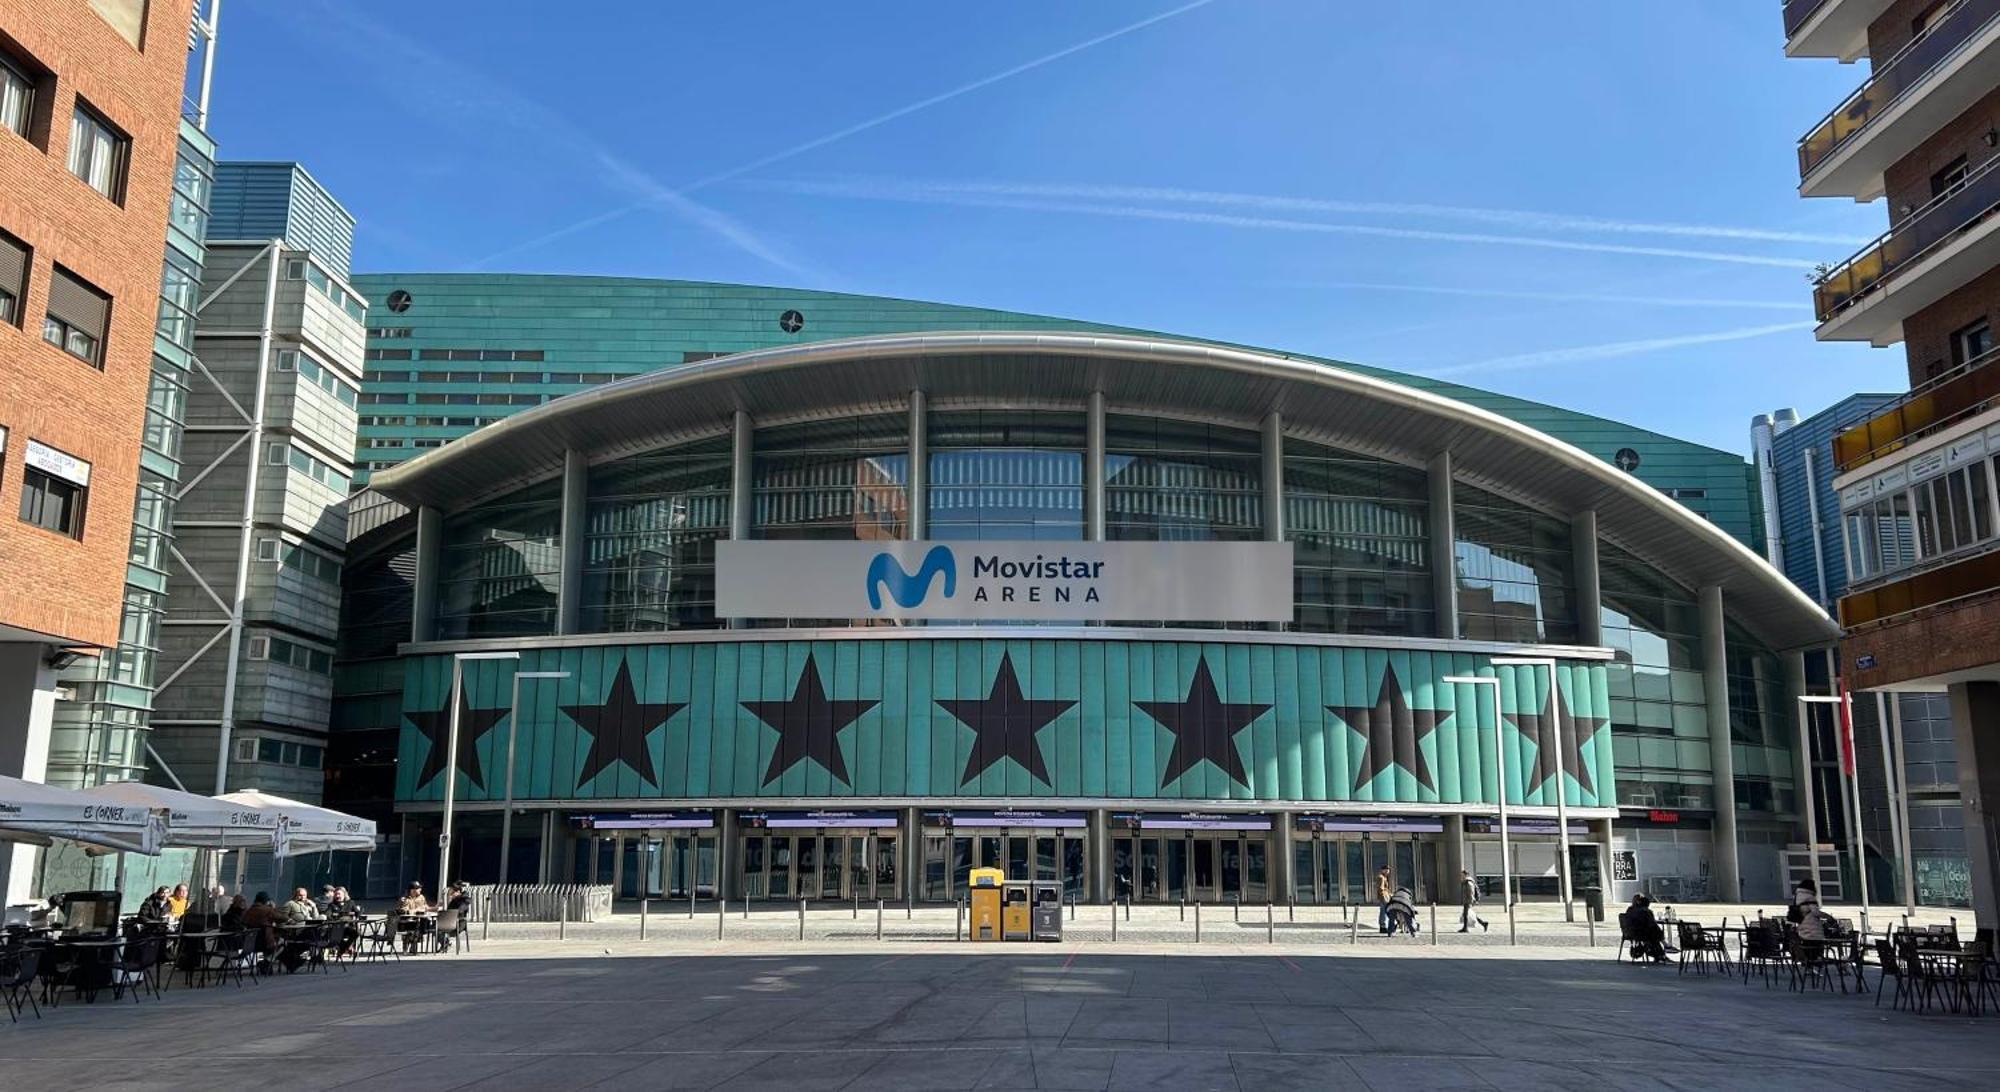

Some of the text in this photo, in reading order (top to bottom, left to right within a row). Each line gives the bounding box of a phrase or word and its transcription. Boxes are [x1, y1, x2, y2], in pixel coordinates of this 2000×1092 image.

[974, 555, 1104, 579] Movistar
[974, 587, 1100, 602] ARENA
[95, 805, 124, 821] CORNER
